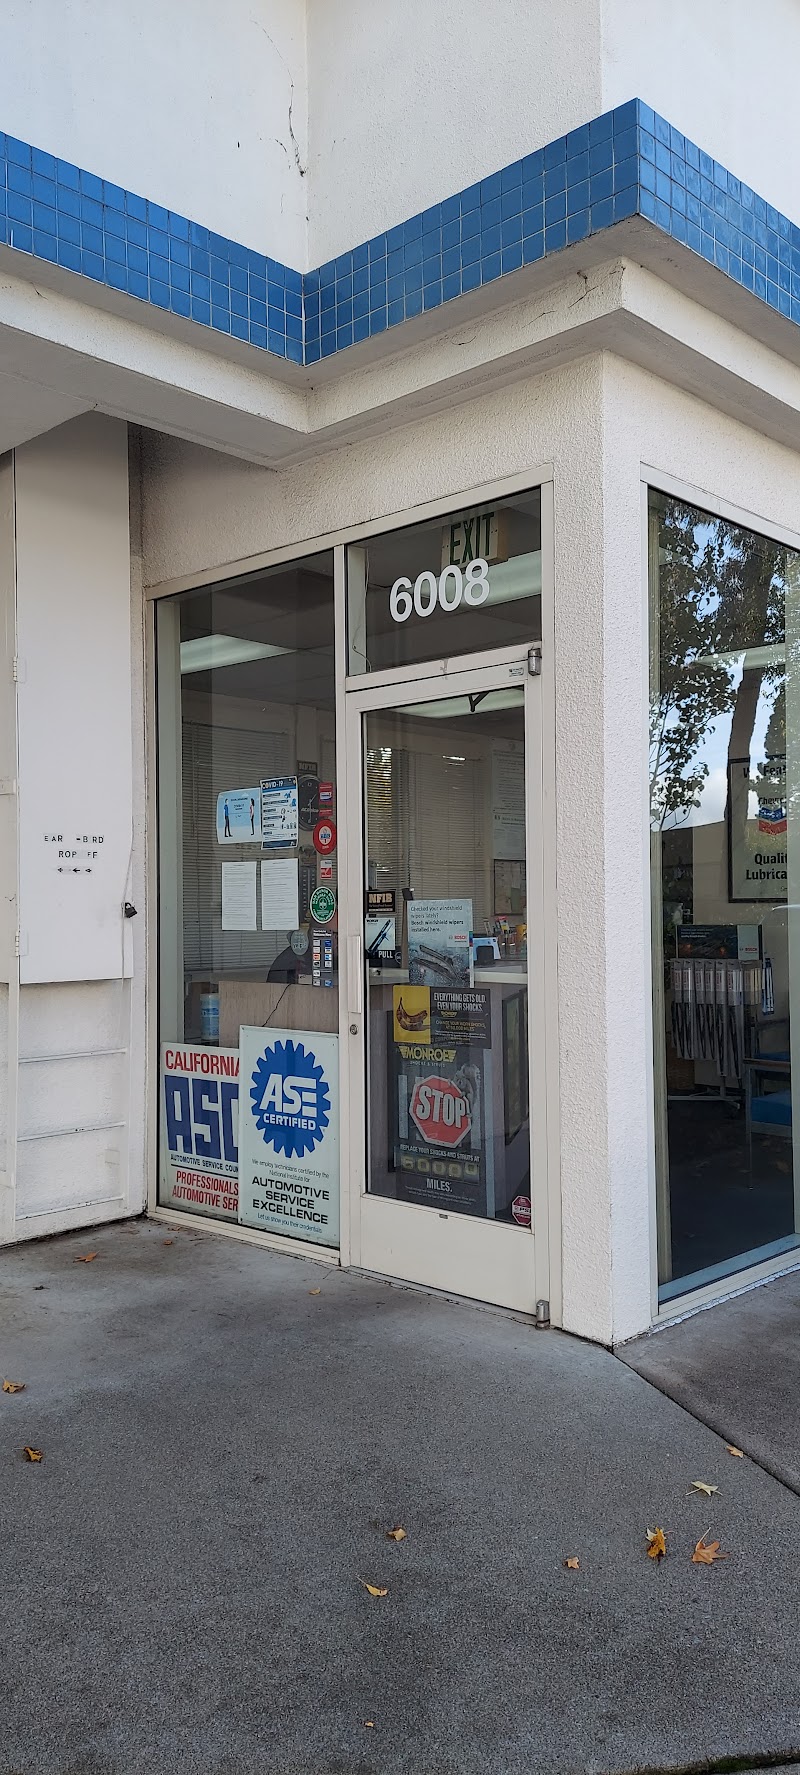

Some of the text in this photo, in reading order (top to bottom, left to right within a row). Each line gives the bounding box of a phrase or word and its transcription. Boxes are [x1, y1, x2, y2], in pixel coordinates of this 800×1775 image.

[450, 512, 494, 565] EXIT
[390, 558, 490, 622] 6008
[262, 780, 283, 789] COVID-19
[746, 869, 787, 880] Lubrica
[368, 893, 392, 903] NFIB
[378, 950, 393, 958] PULL
[434, 992, 486, 1003] EVERYTHING GETS OLD.
[437, 1002, 483, 1012] EVEN YOUR SHOCKS.
[406, 1046, 450, 1062] MONROE
[259, 1074, 317, 1117] ASE
[416, 1086, 465, 1128] STOP
[263, 1113, 316, 1130] CERTIFIED
[400, 1144, 418, 1153] REPLACE
[419, 1147, 429, 1155] YOUR
[430, 1148, 446, 1157] SHOCKS
[457, 1153, 473, 1161] STRUTS
[171, 1154, 200, 1166] AUTOMOTIVE
[202, 1160, 223, 1170] SERVICE
[260, 1160, 274, 1168] employ
[275, 1163, 297, 1172] technicians
[298, 1167, 315, 1175] certified
[316, 1170, 321, 1178] by
[269, 1170, 286, 1178] National
[176, 1170, 239, 1196] PROFESSIONALS
[252, 1176, 330, 1200] AUTOMOTIVE
[172, 1185, 220, 1207] AUTOMOTIVE
[266, 1190, 314, 1209] SERVICE
[252, 1199, 328, 1224] EXCELLENCE
[290, 1220, 299, 1228] their
